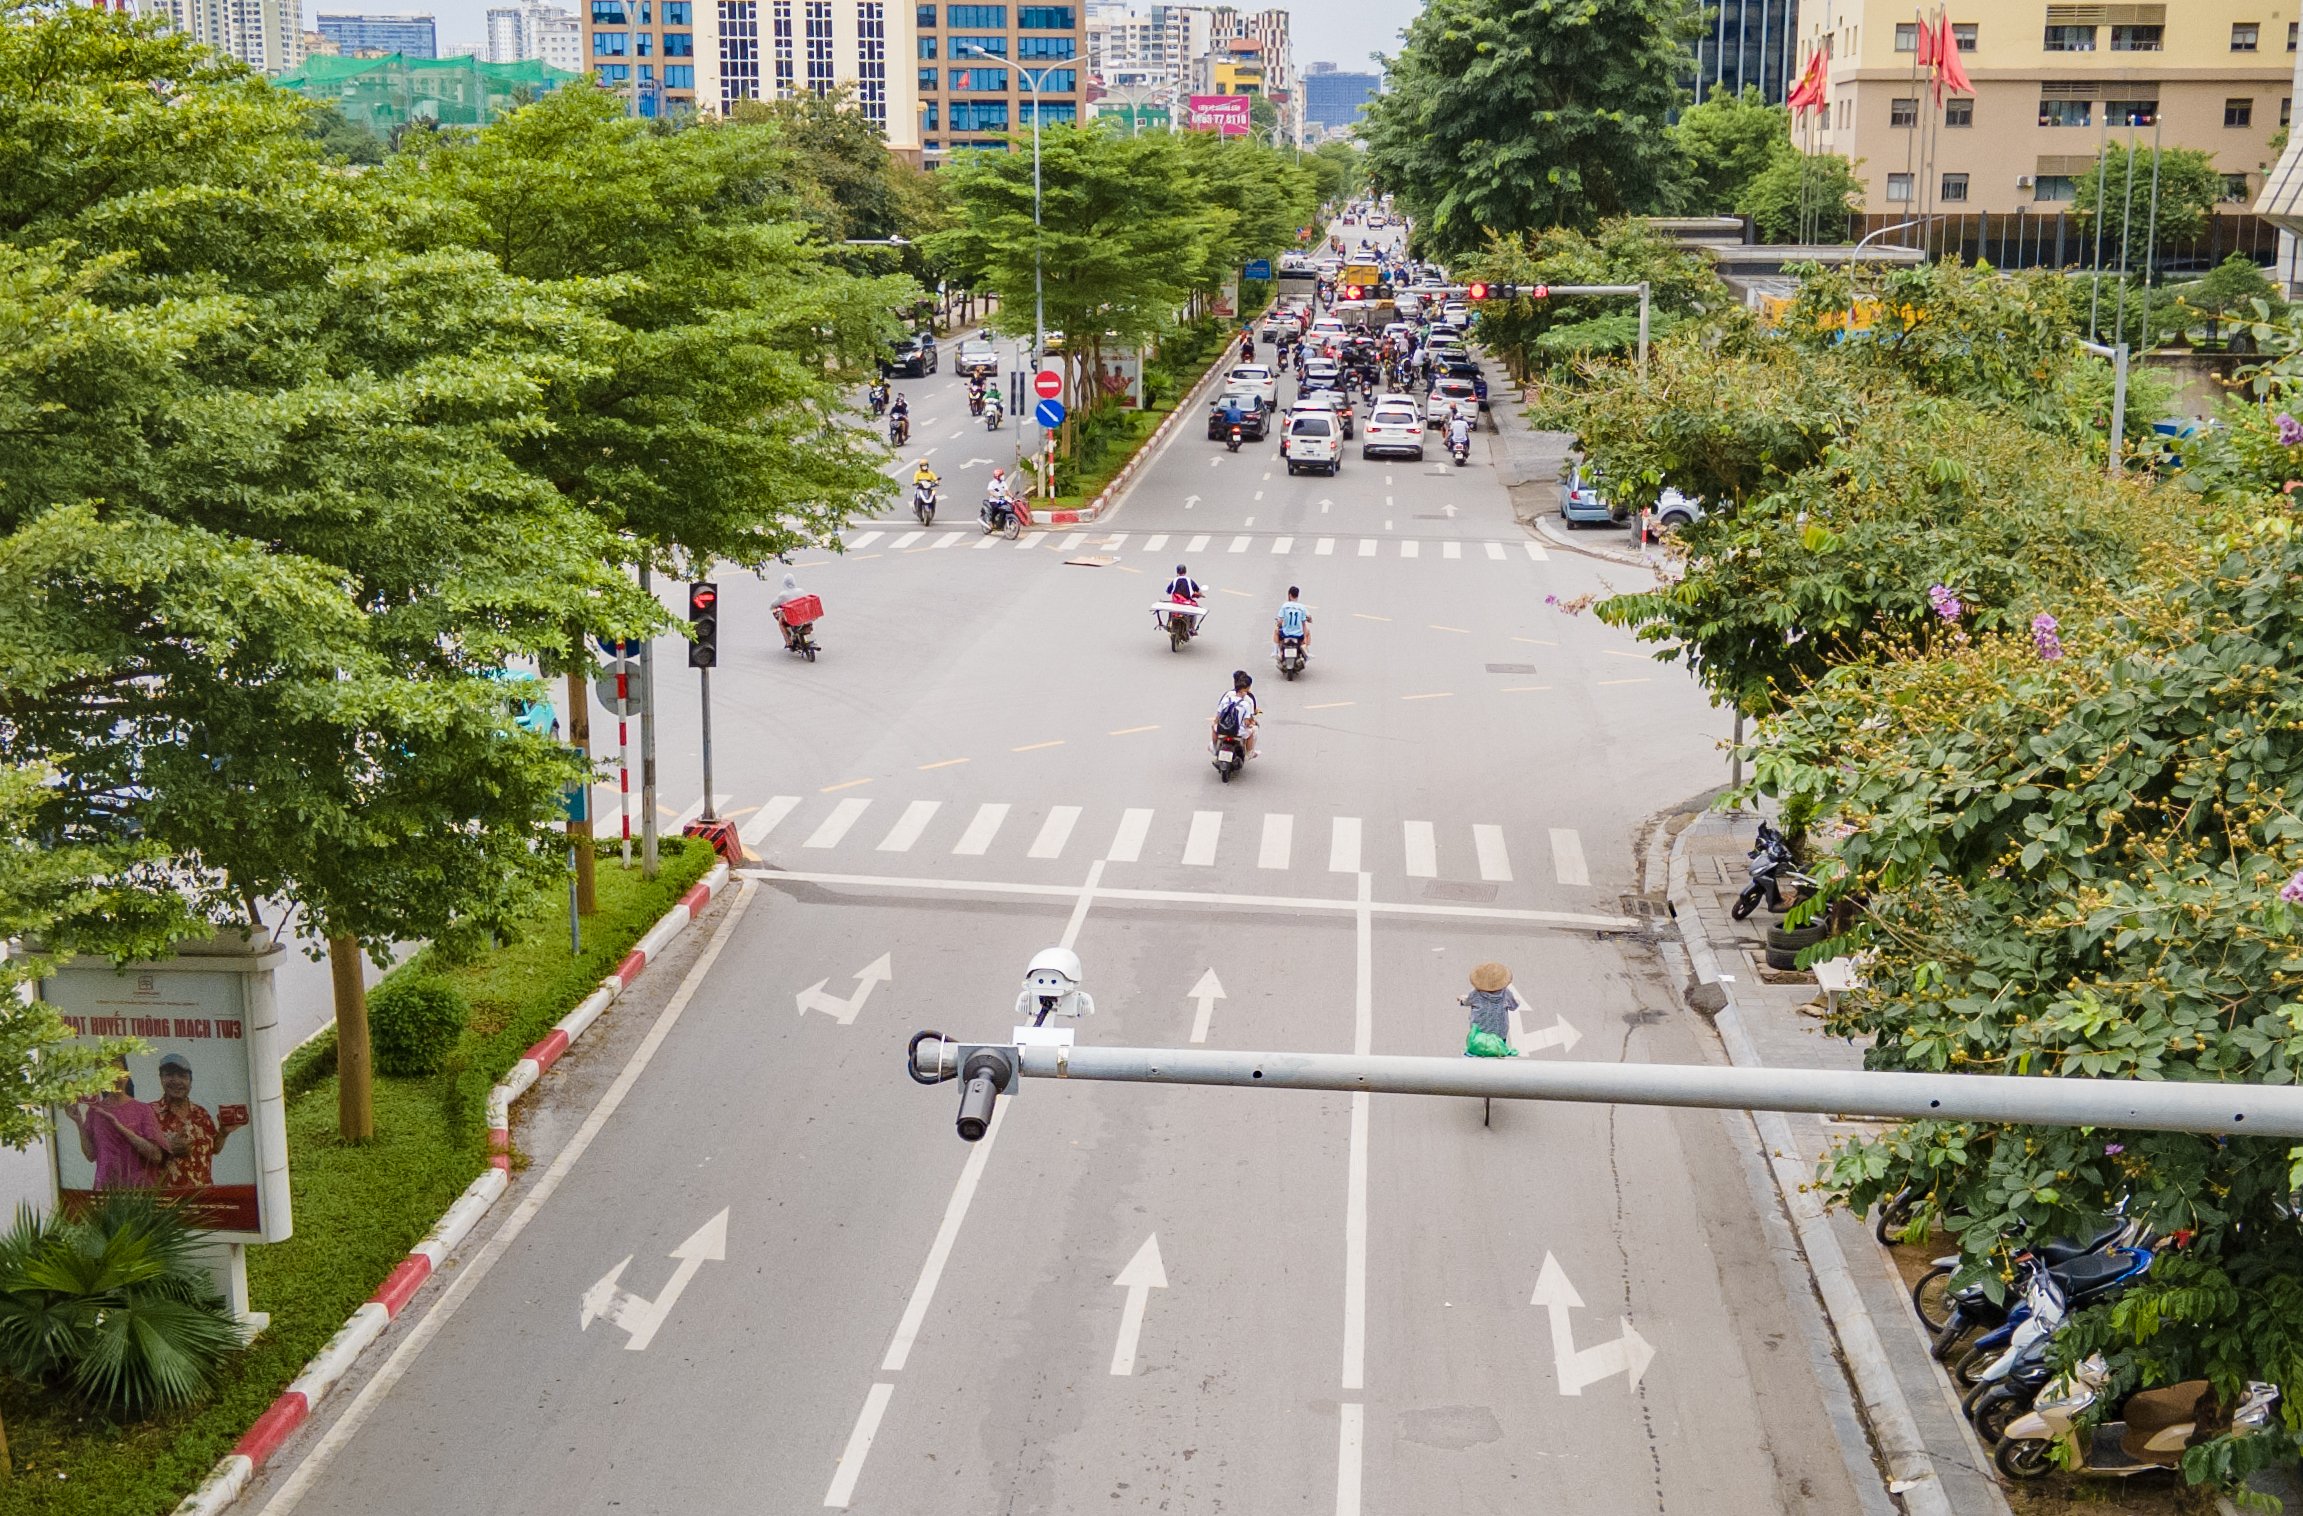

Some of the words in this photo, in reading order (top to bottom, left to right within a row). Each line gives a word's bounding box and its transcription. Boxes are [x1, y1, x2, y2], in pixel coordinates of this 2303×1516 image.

[1213, 114, 1225, 124] 77
[1289, 611, 1299, 626] 11
[90, 1010, 127, 1037] HUYẾT
[131, 1014, 170, 1038] THÔNG
[174, 1017, 211, 1043] MẠCH
[214, 1018, 242, 1039] TW3
